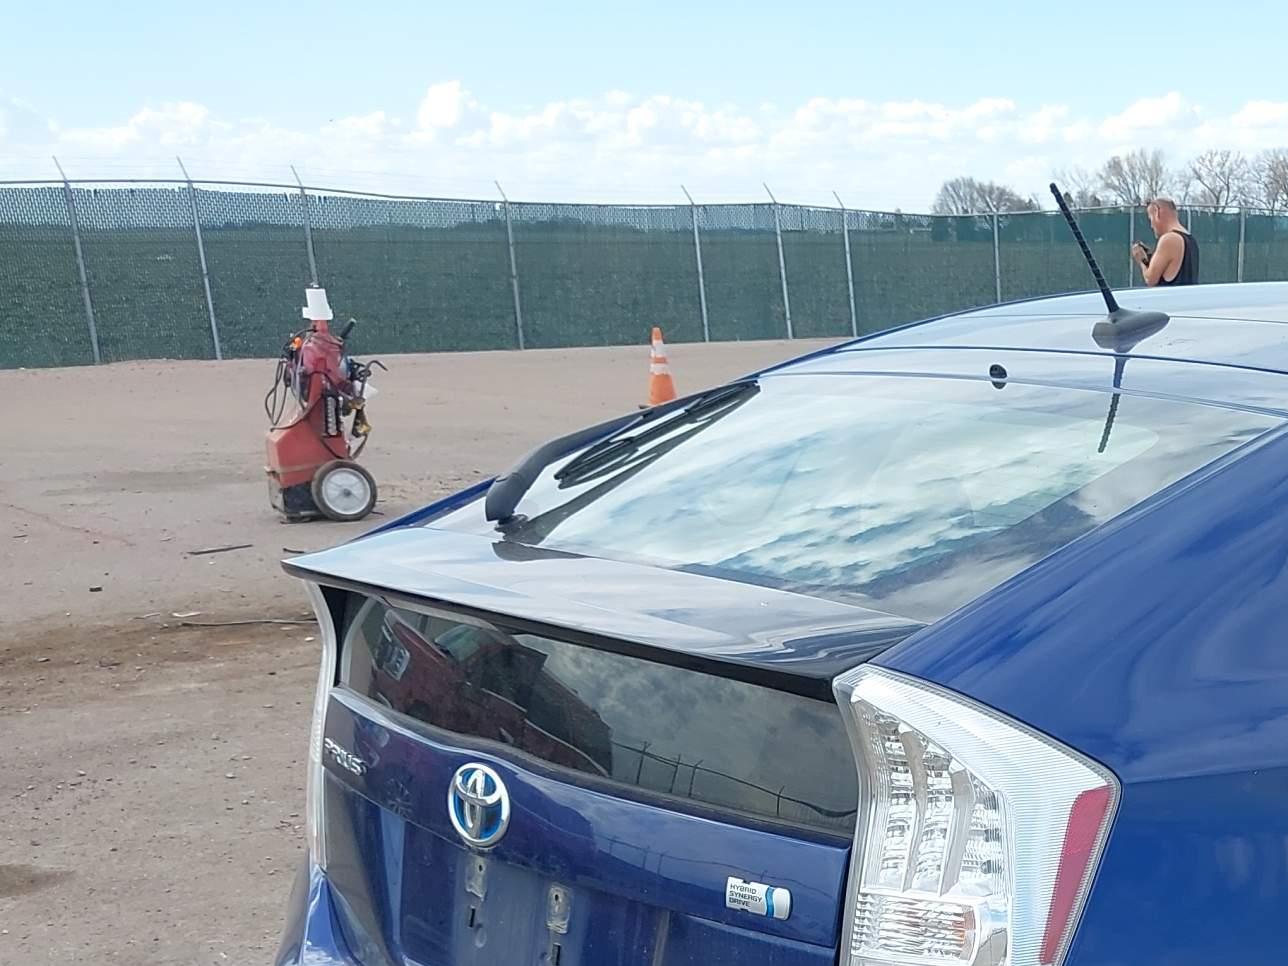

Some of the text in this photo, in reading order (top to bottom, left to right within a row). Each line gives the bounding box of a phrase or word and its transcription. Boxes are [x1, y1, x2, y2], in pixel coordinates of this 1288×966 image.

[730, 883, 757, 895] HYBRID
[729, 890, 762, 903] SYNERGY
[729, 896, 751, 908] DRIVE
